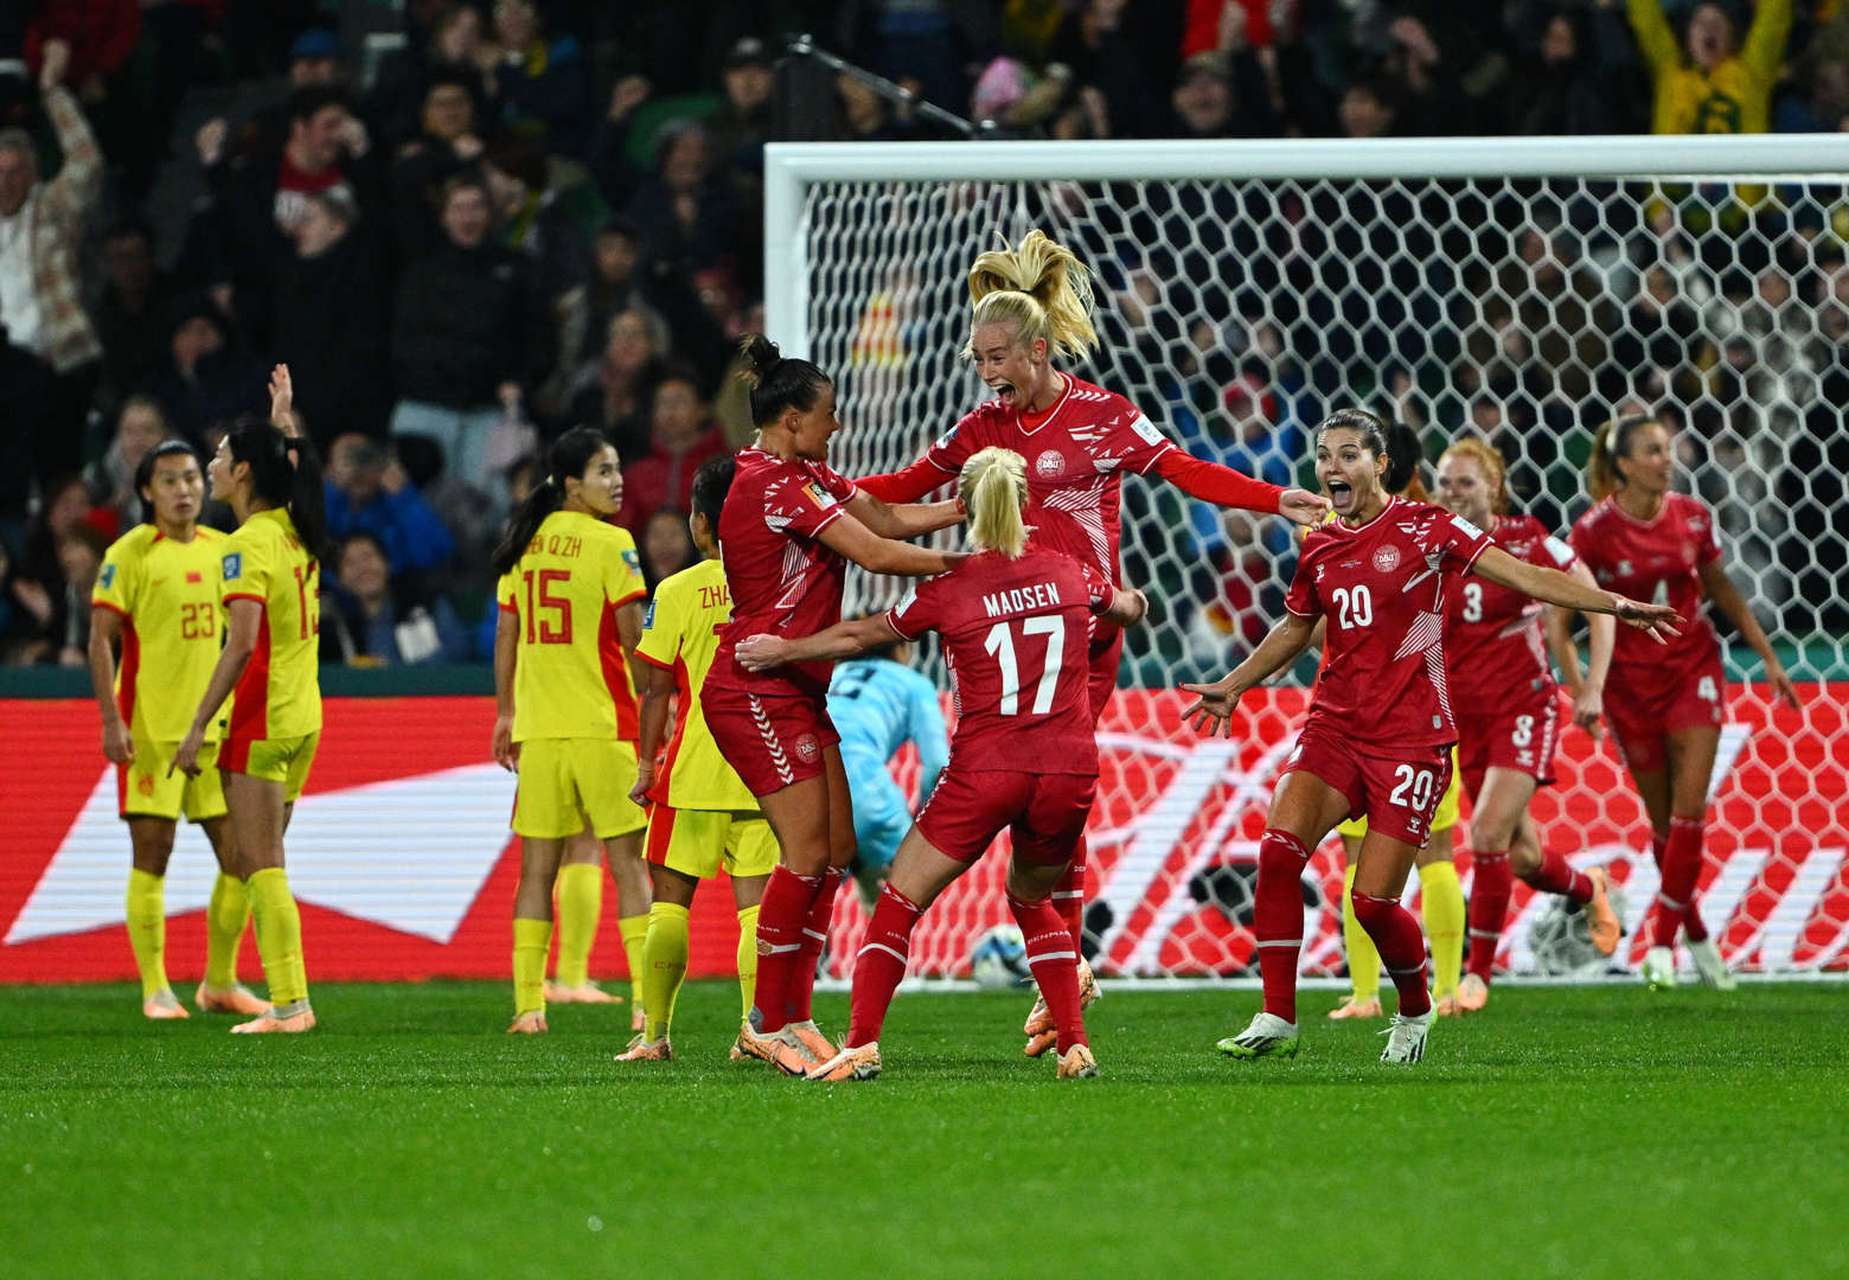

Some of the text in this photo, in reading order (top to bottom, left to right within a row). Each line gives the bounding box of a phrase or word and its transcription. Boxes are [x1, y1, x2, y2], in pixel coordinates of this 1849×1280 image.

[181, 604, 214, 639] 23
[524, 569, 572, 644] 15
[983, 582, 1061, 618] MADSEN
[1332, 584, 1373, 630] 20
[1462, 582, 1483, 623] 3
[984, 614, 1065, 716] 17
[1697, 675, 1719, 703] 4
[1390, 764, 1433, 811] 20
